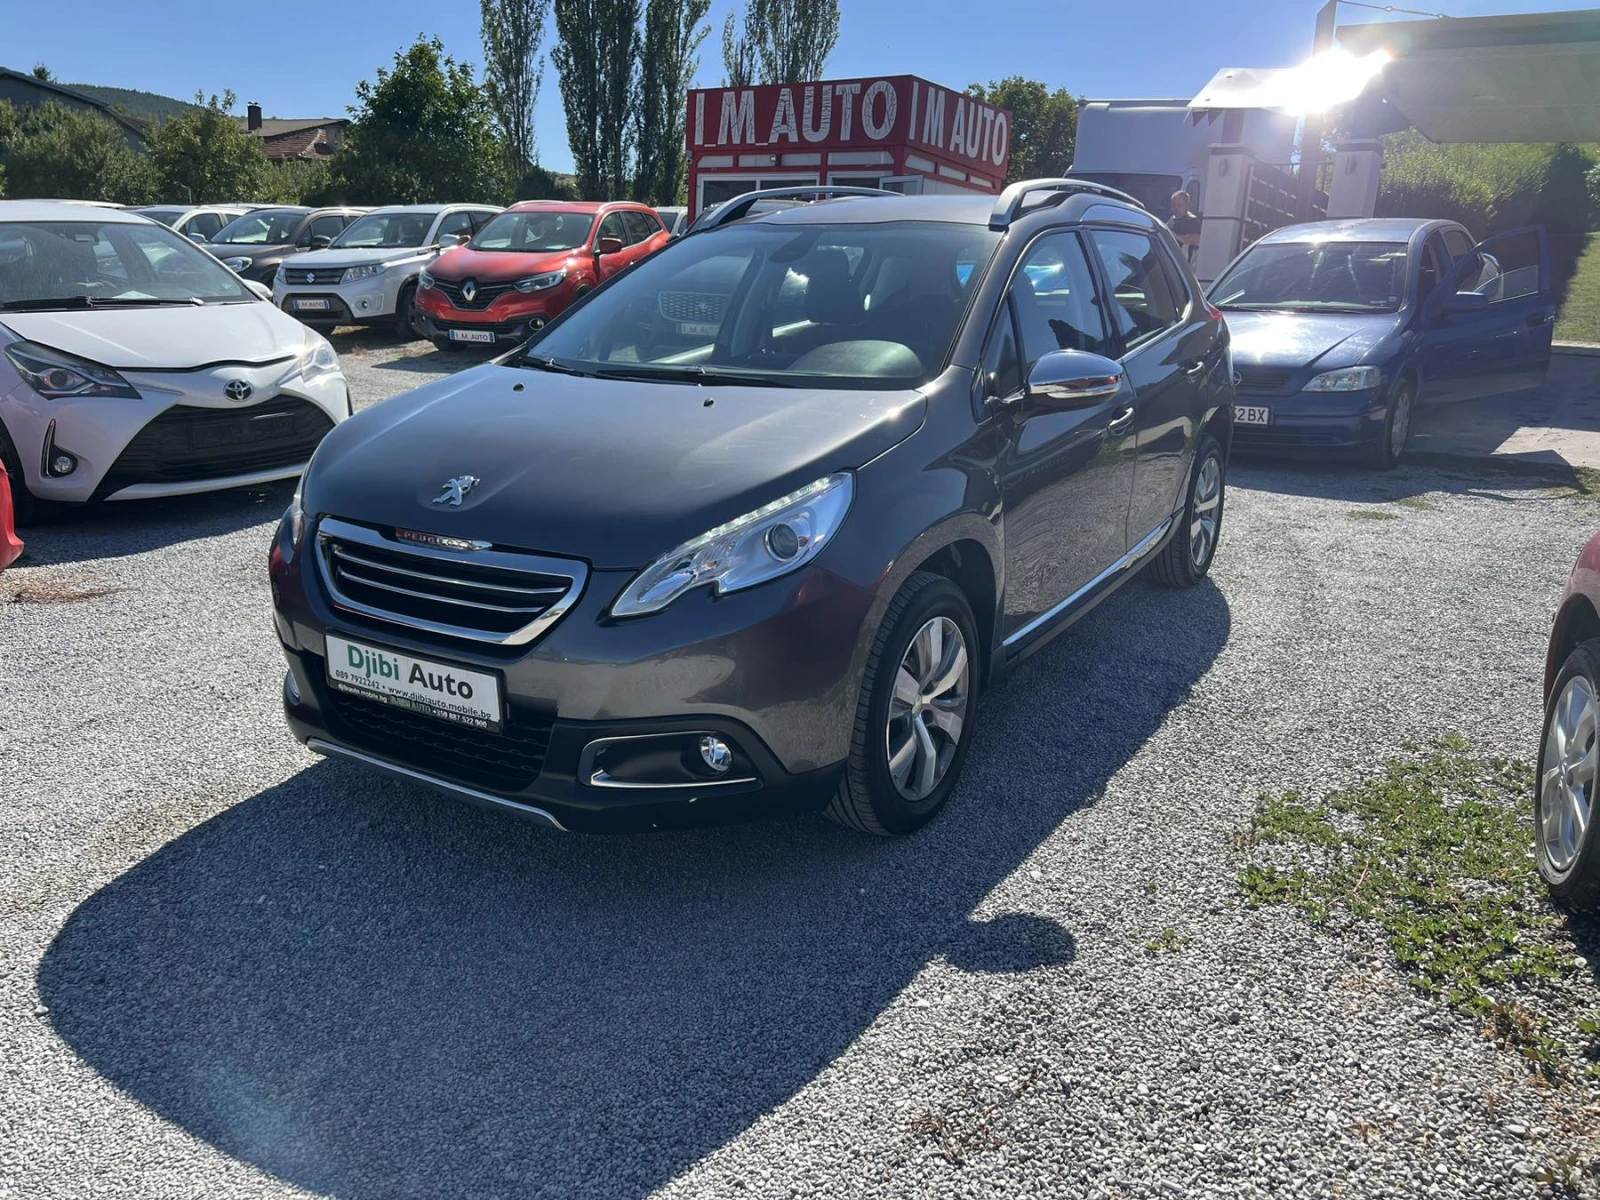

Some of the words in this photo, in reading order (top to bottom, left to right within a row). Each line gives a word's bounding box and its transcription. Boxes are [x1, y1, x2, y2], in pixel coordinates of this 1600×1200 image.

[908, 81, 919, 141] I
[922, 86, 946, 149] M
[950, 97, 1008, 166] AUTO
[335, 669, 348, 680] 089
[347, 644, 399, 680] Djibi
[408, 663, 473, 699] Auto
